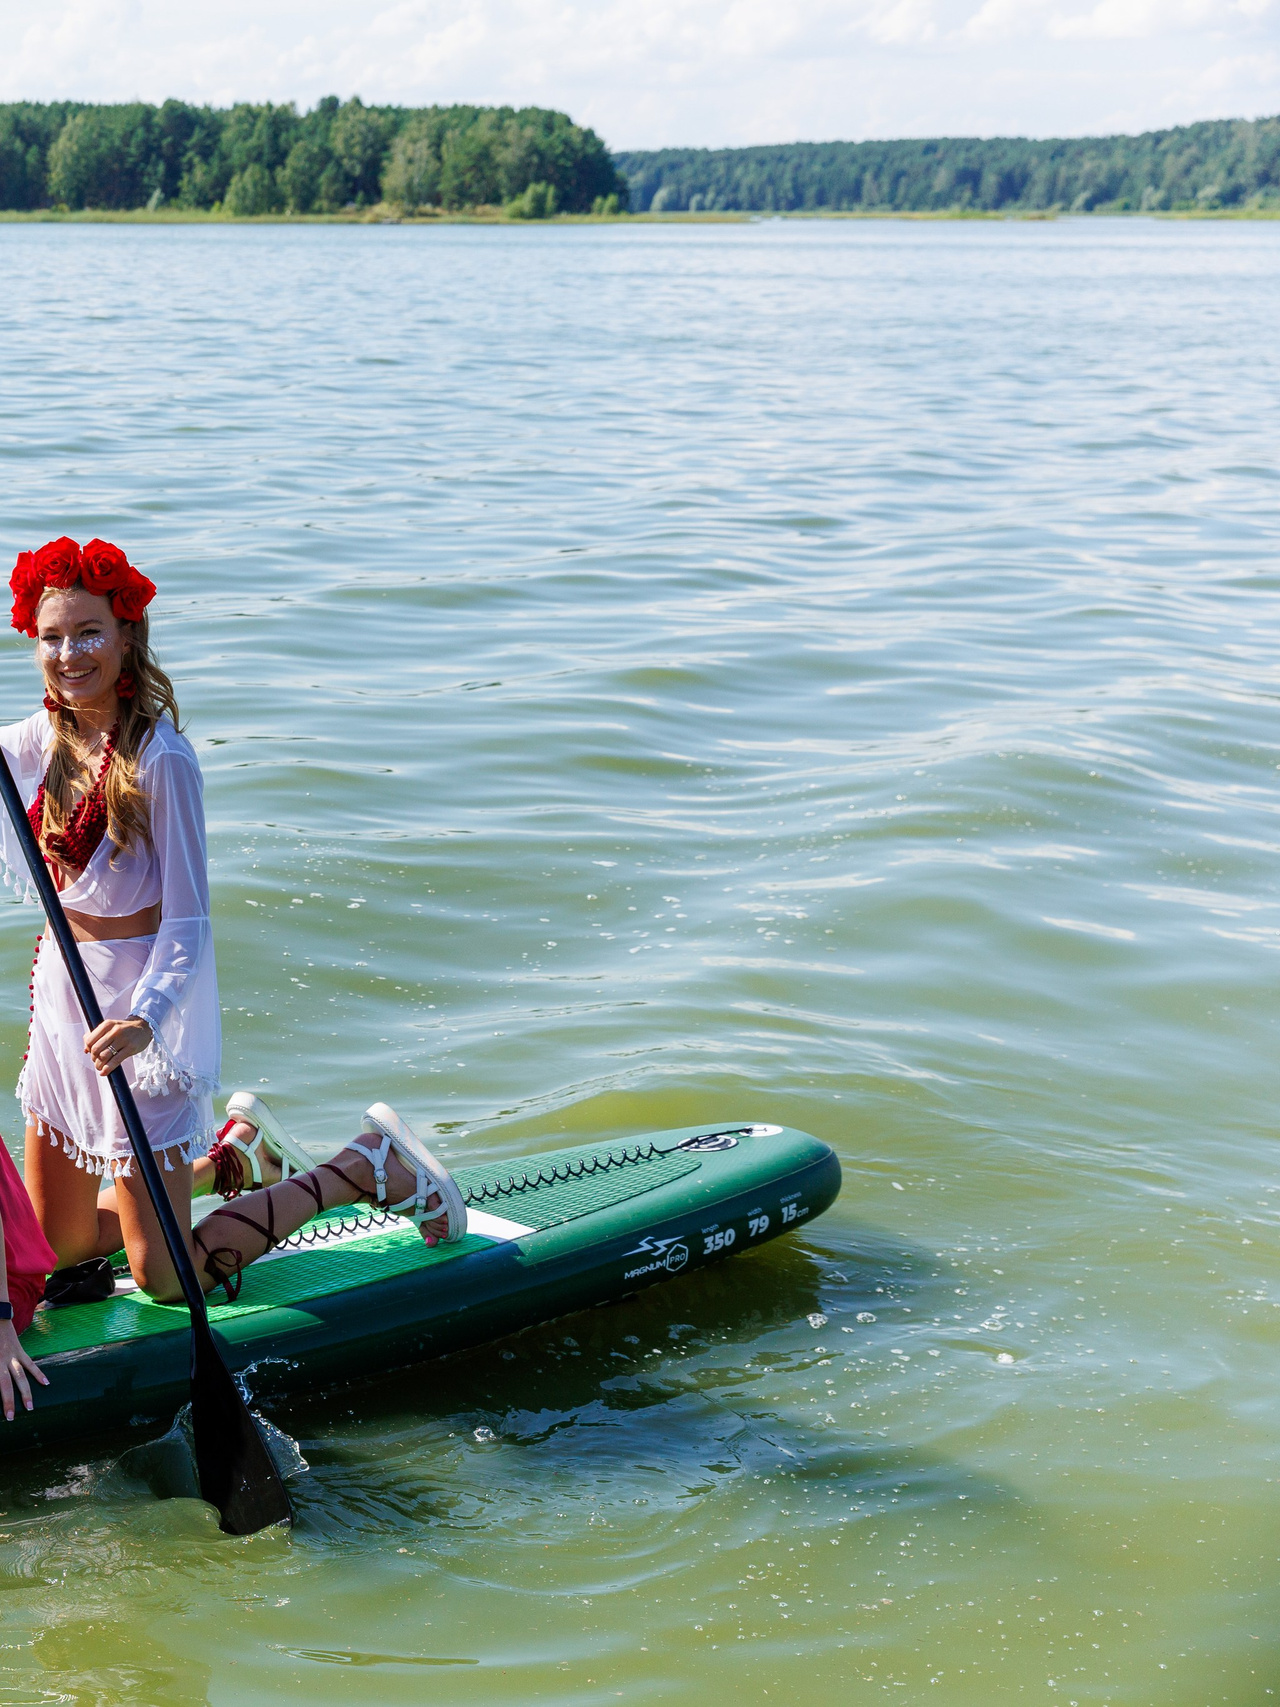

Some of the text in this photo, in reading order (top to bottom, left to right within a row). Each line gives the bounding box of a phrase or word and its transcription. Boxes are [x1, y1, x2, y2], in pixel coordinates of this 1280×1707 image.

[748, 1215, 770, 1237] 79
[703, 1228, 735, 1255] 350
[624, 1253, 686, 1280] MAGNUM PRO
